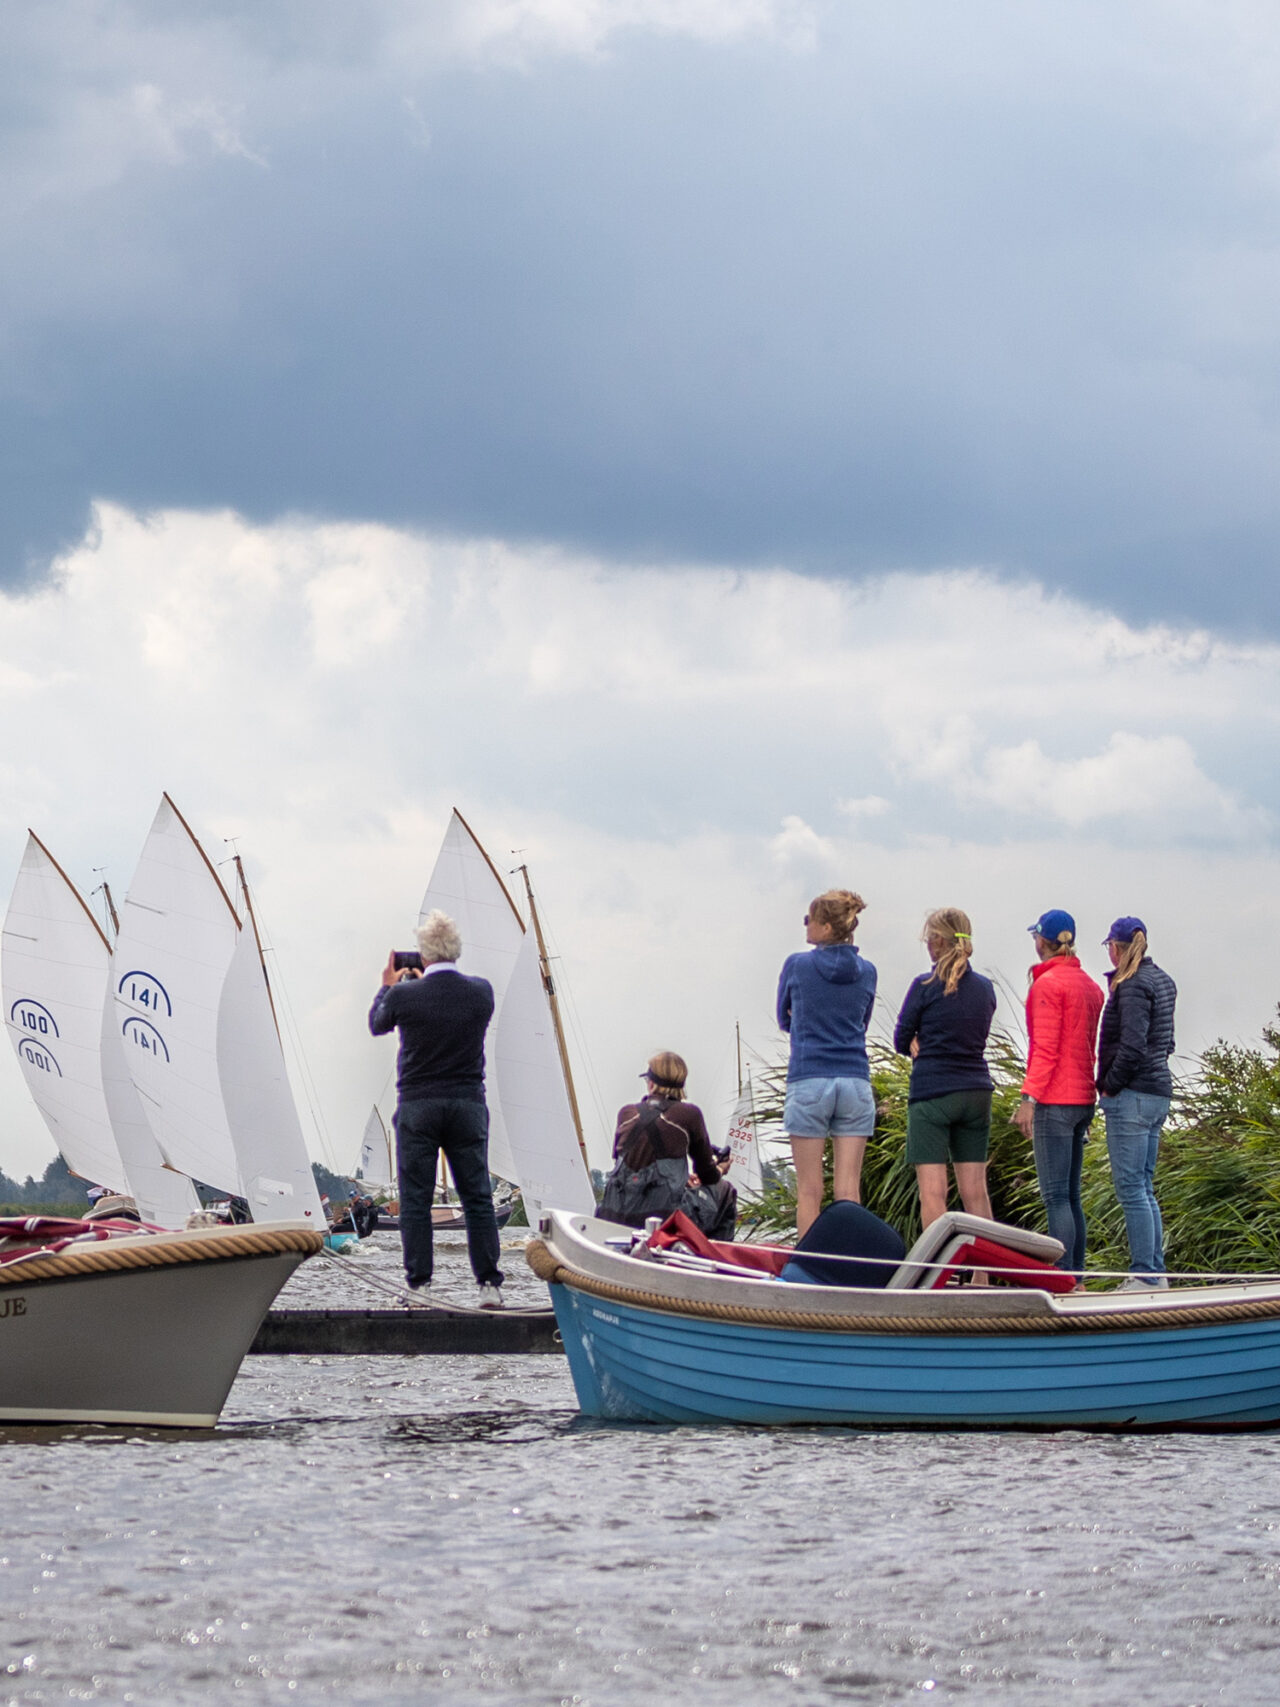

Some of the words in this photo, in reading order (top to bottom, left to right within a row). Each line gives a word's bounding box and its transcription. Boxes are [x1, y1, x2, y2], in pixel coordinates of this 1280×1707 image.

[131, 982, 158, 1011] 141
[20, 1009, 48, 1034] 100
[728, 1127, 753, 1142] 2325
